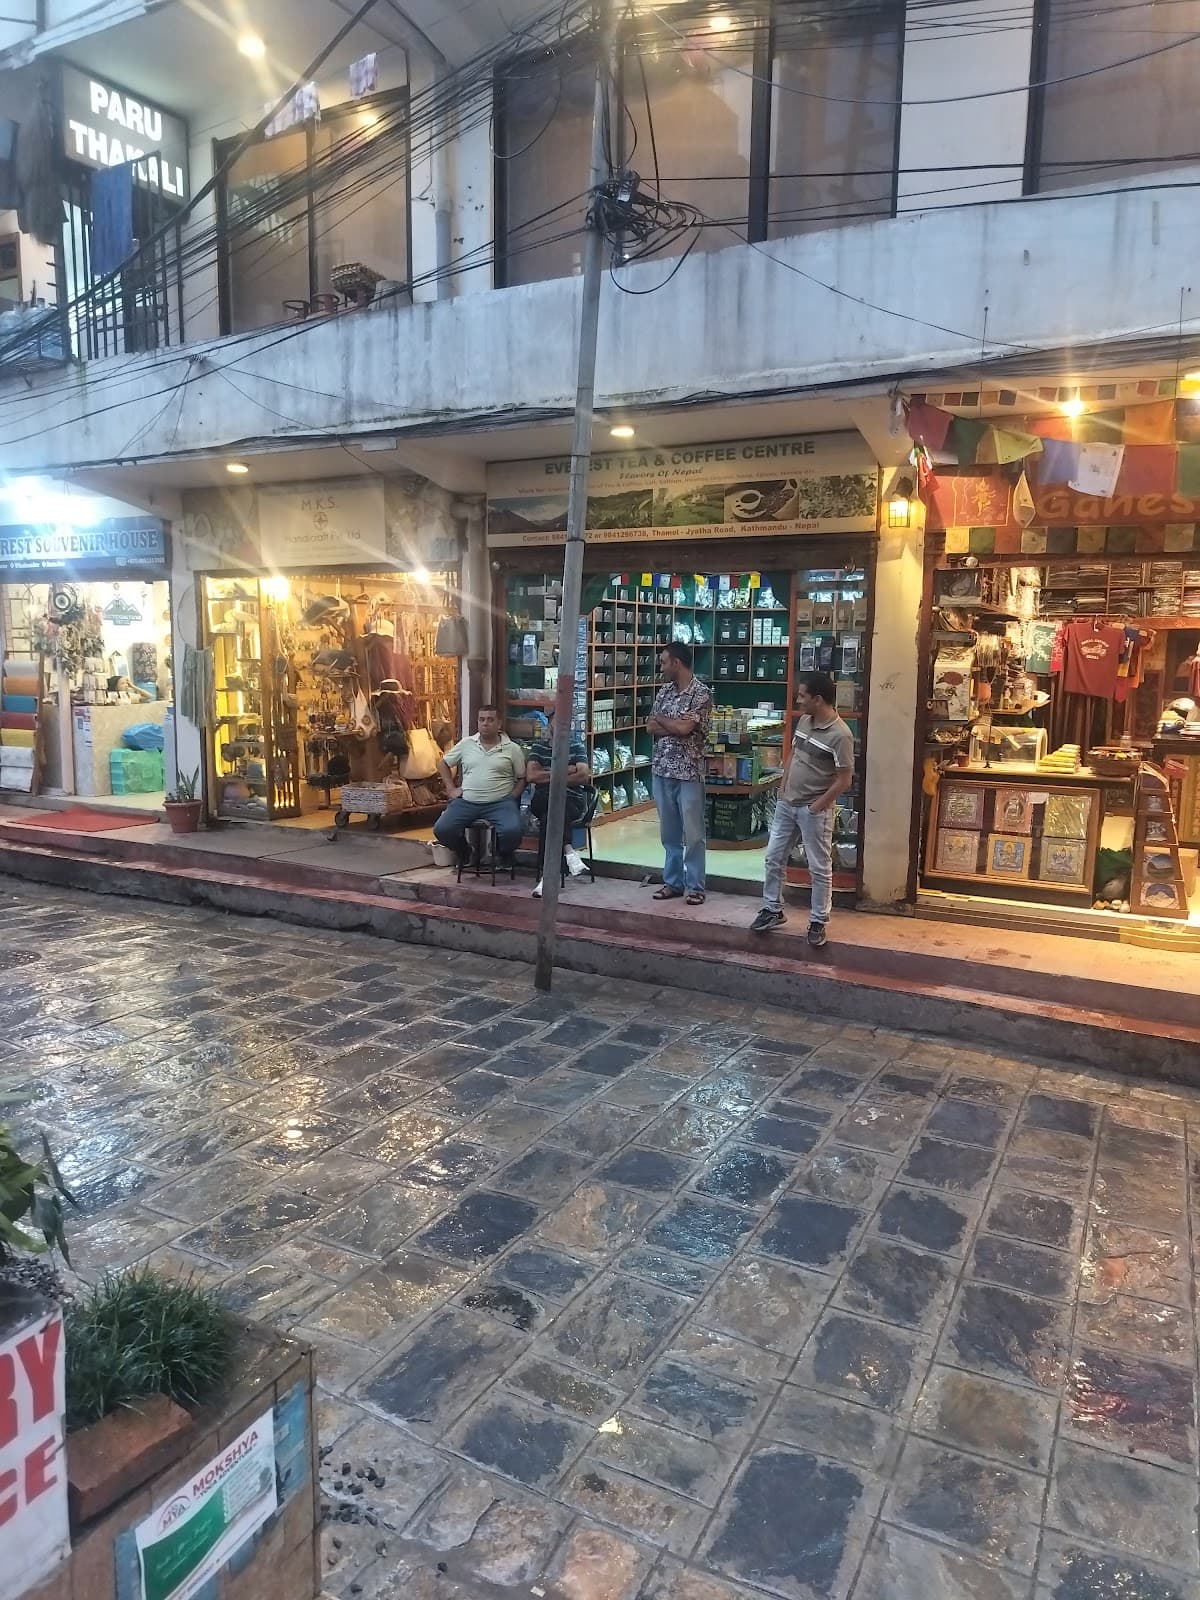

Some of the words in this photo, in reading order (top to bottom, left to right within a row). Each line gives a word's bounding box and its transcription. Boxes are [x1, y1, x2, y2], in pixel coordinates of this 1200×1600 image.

[90, 81, 162, 141] PARU
[69, 119, 184, 198] THAKALI
[545, 458, 613, 475] EVEST
[618, 455, 648, 469] TEA
[653, 453, 665, 467] &
[671, 448, 736, 466] COFFEE
[742, 441, 816, 460] CENTRE
[672, 467, 704, 477] Nepal
[0, 537, 32, 555] REST
[35, 533, 105, 553] SOUVENIR
[108, 530, 158, 549] HOUSE
[740, 523, 787, 532] Kathmandu
[795, 521, 820, 531] Nepal
[192, 1431, 259, 1497] MOKSHYA
